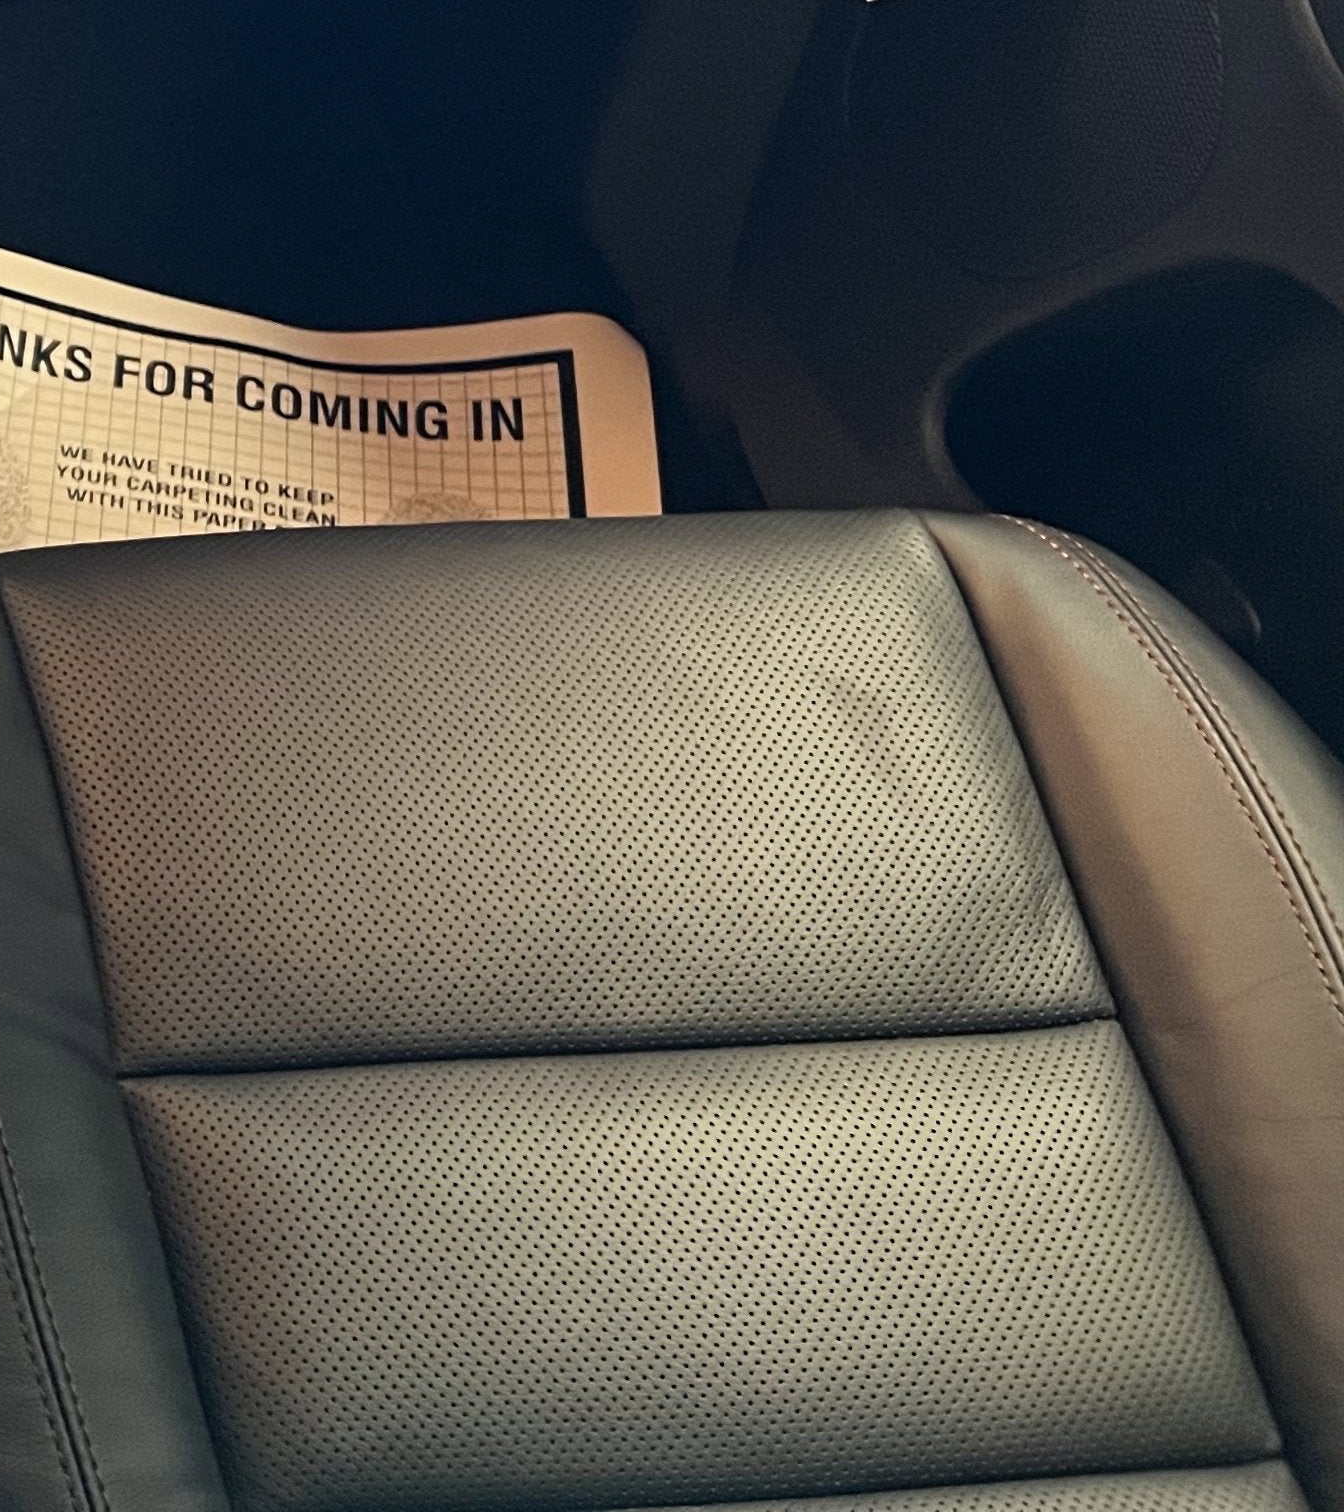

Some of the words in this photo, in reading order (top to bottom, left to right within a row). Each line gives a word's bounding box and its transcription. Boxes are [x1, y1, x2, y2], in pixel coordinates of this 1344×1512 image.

[113, 352, 215, 404] FOR
[236, 374, 449, 441] COMING
[471, 396, 524, 442] IN
[57, 464, 117, 488] YOUR
[126, 475, 255, 513] CARPETING
[263, 501, 336, 528] CLEAN
[60, 444, 94, 463] WE
[102, 450, 159, 473] HAVE
[168, 463, 233, 488] TRIED
[241, 475, 270, 496] TO
[278, 482, 335, 507] KEEP
[66, 487, 125, 509] WITH
[134, 496, 185, 520] THIS
